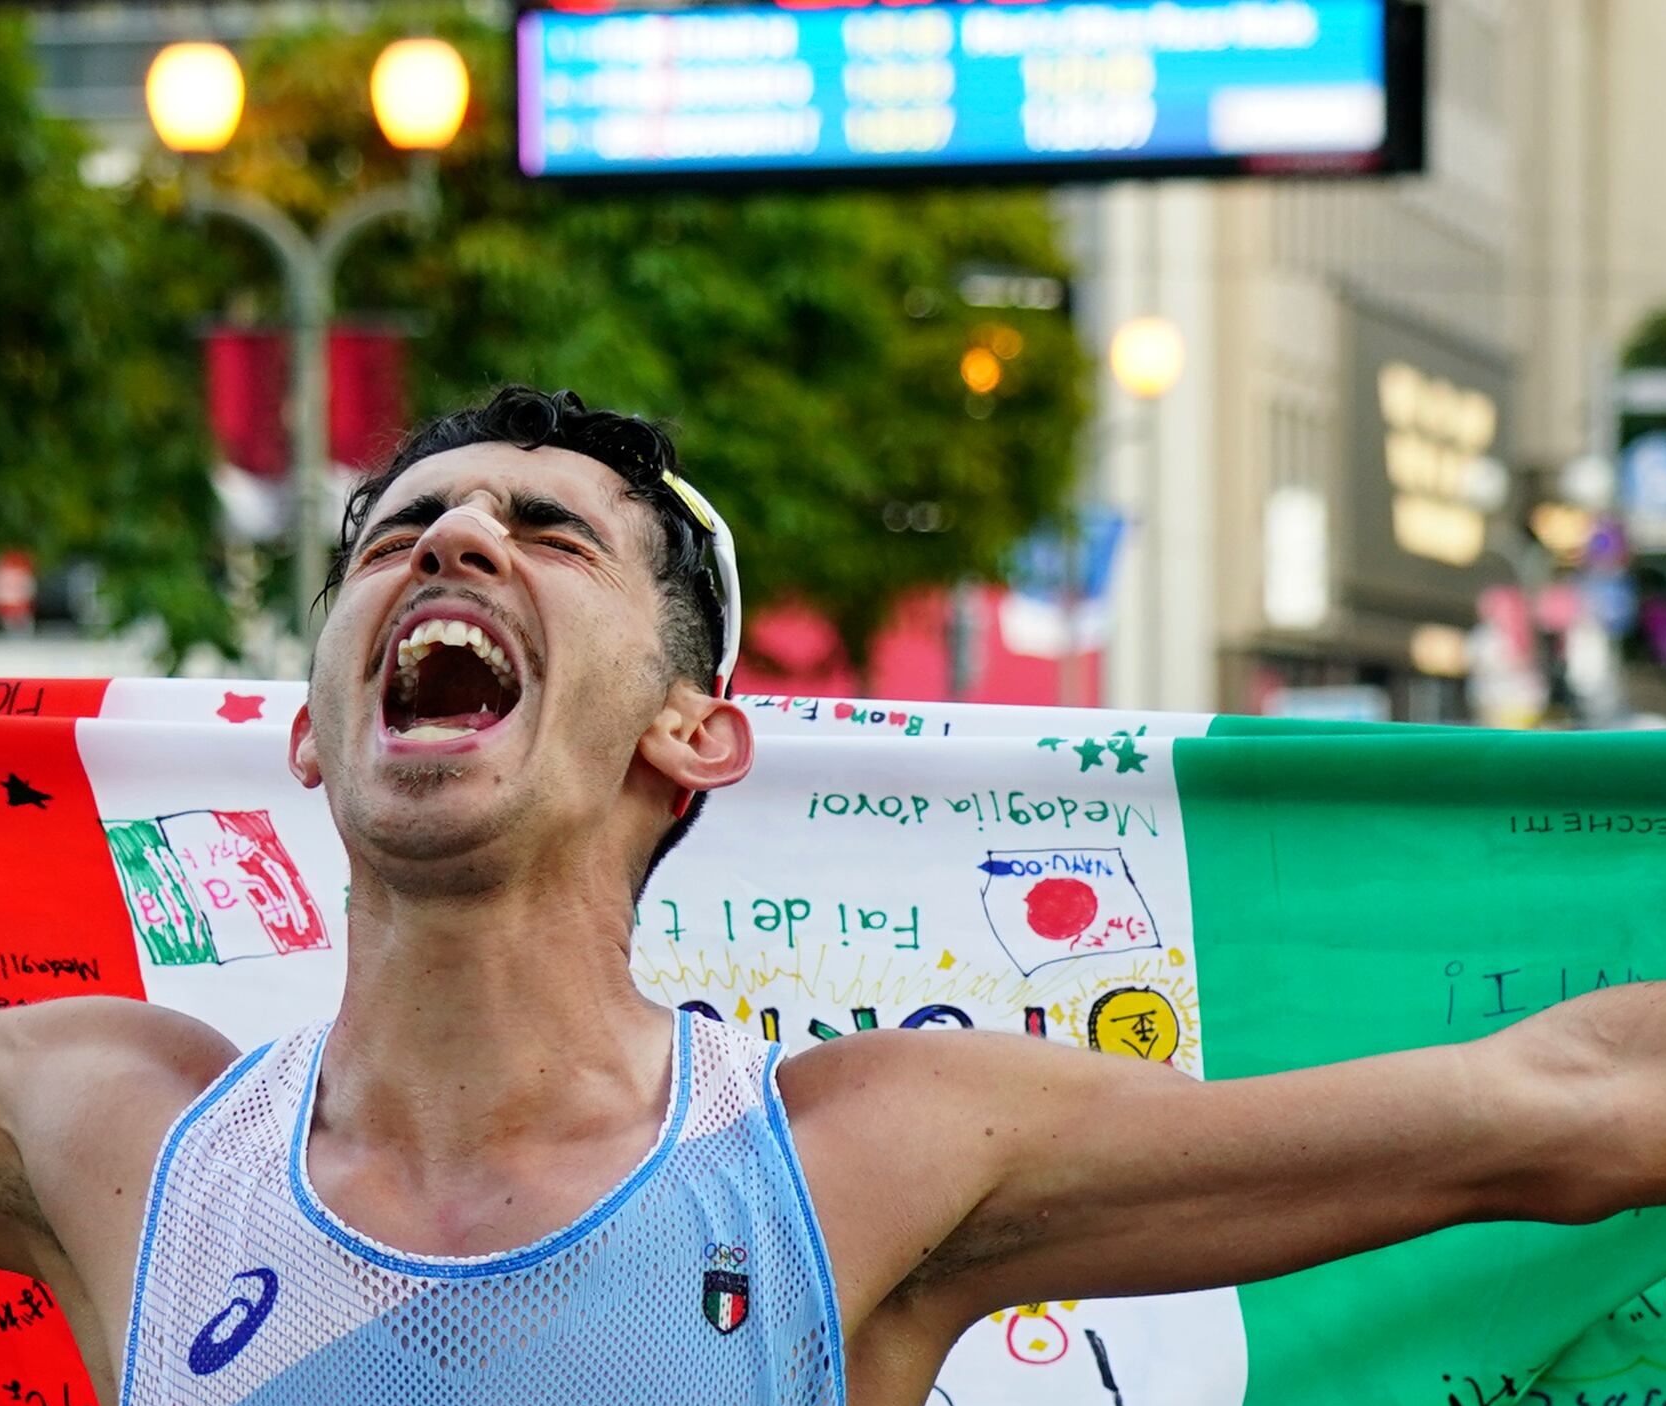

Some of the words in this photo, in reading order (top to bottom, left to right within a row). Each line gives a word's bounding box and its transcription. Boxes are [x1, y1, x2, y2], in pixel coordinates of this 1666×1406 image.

[807, 792, 929, 827] d'oro!
[946, 790, 1159, 837] Medaglia
[837, 902, 919, 949] Fai
[1109, 1009, 1159, 1060] 金
